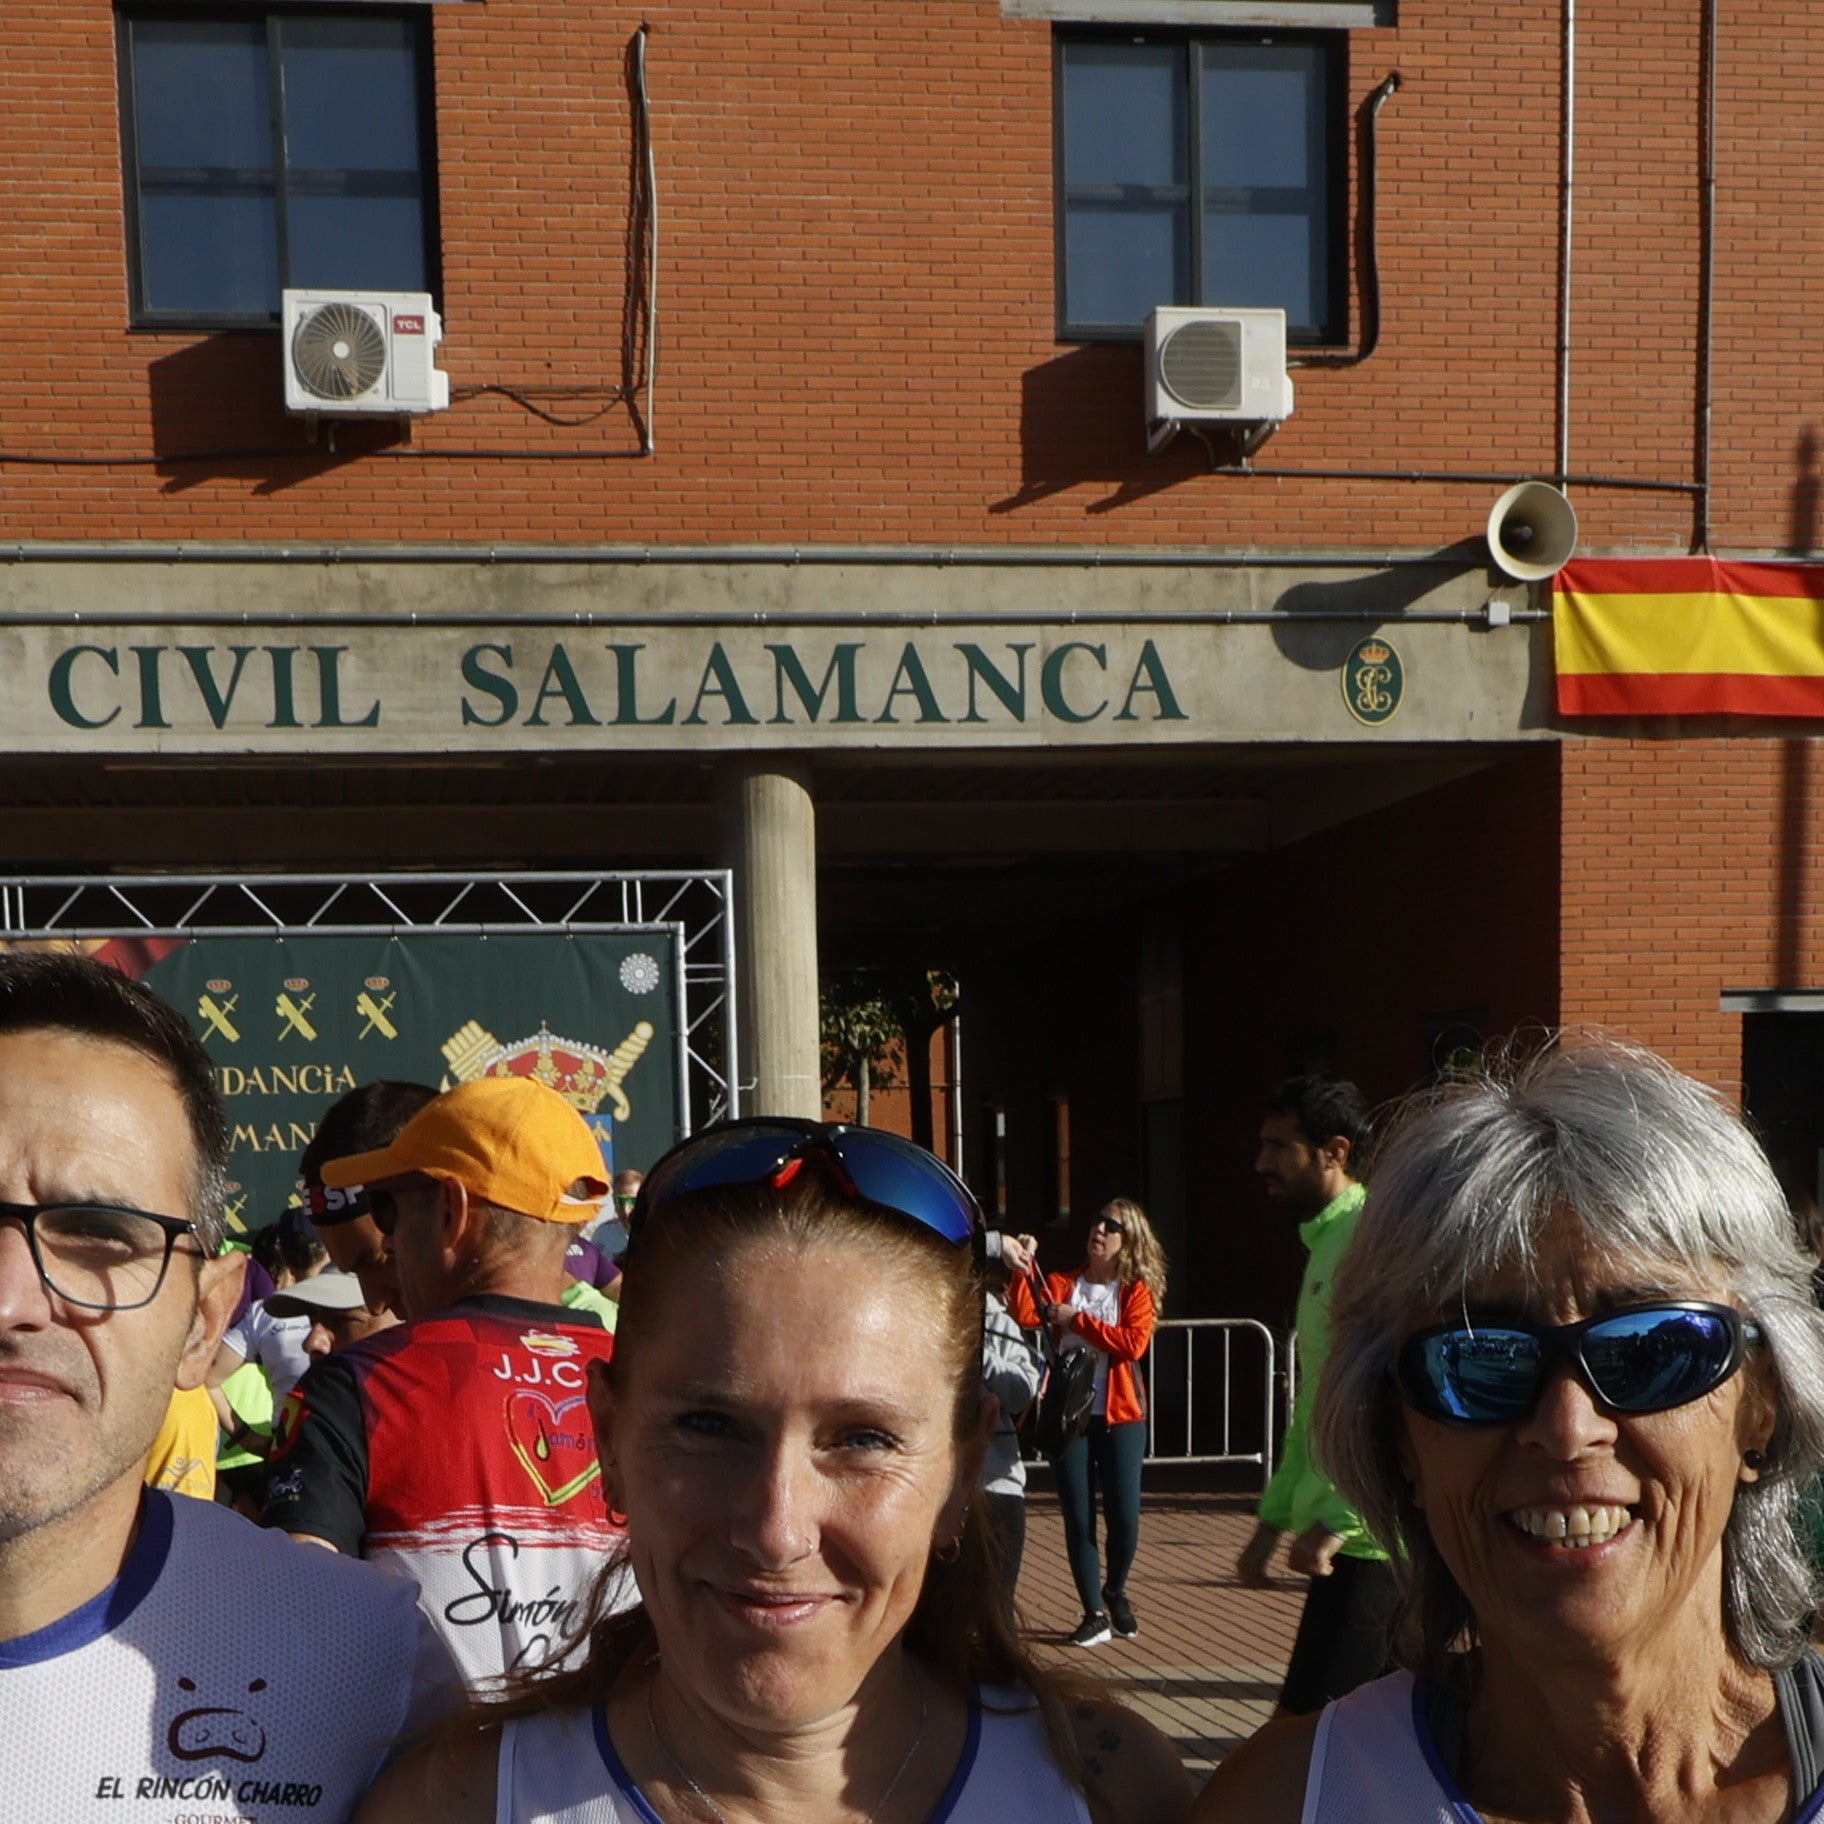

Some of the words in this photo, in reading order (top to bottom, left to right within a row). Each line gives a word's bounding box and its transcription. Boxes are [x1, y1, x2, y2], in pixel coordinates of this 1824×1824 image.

[397, 320, 422, 330] TCL
[49, 645, 383, 731] CIVIL
[462, 638, 1190, 727] SALAMANCA
[95, 1775, 124, 1802] EL
[135, 1773, 231, 1803] RINCÓN
[236, 1779, 323, 1808] CHARRO
